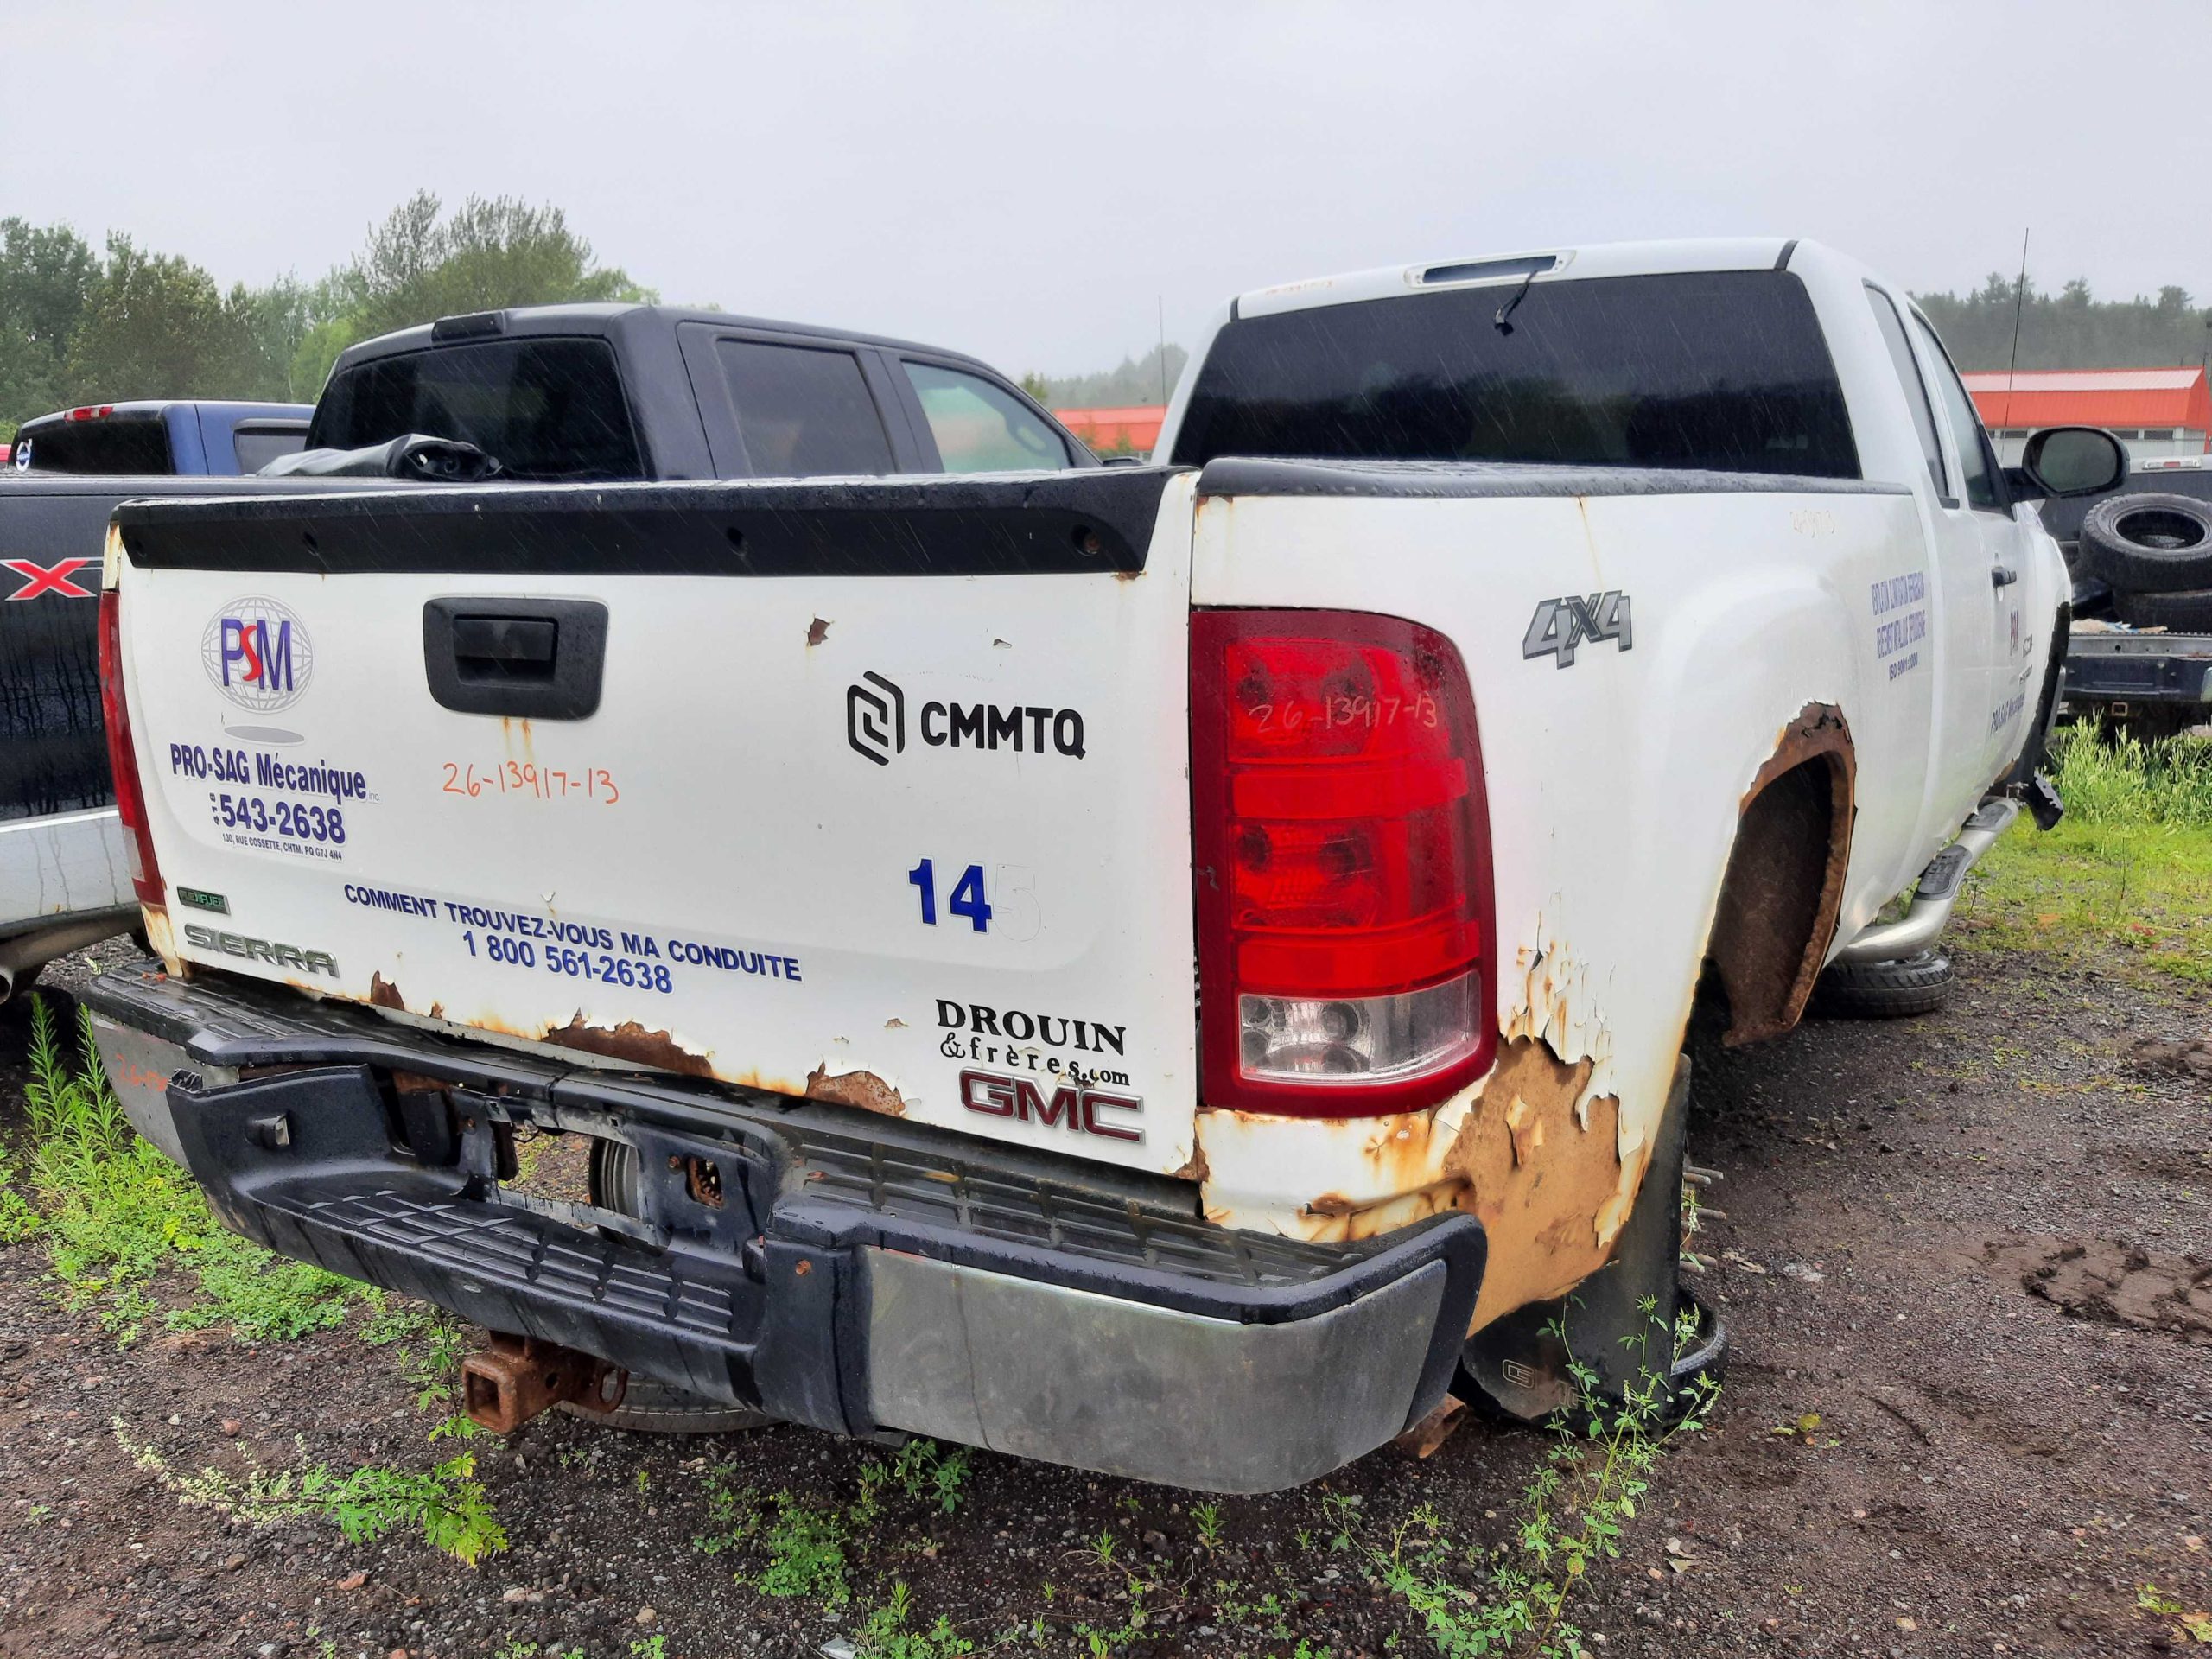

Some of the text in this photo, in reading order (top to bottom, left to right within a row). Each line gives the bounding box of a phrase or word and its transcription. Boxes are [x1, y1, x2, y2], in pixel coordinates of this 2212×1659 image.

[220, 618, 294, 691] PSM
[920, 701, 1086, 760] CMMTQ
[169, 742, 251, 785] PRO-SAG
[255, 752, 367, 805] Mécanique
[442, 760, 620, 804] 26-13917-13
[219, 793, 346, 844] 543-2638
[235, 835, 249, 846] RUE
[303, 846, 315, 857] PQ
[328, 849, 343, 861] 4N4
[184, 922, 340, 980] SIERRA
[344, 884, 803, 982] COMMENT TROUVEZ-VOUS MA CONDUITE
[462, 930, 673, 995] 1 800 561-2638
[936, 999, 1127, 1057] DROUIN
[959, 1065, 1146, 1146] GMC
